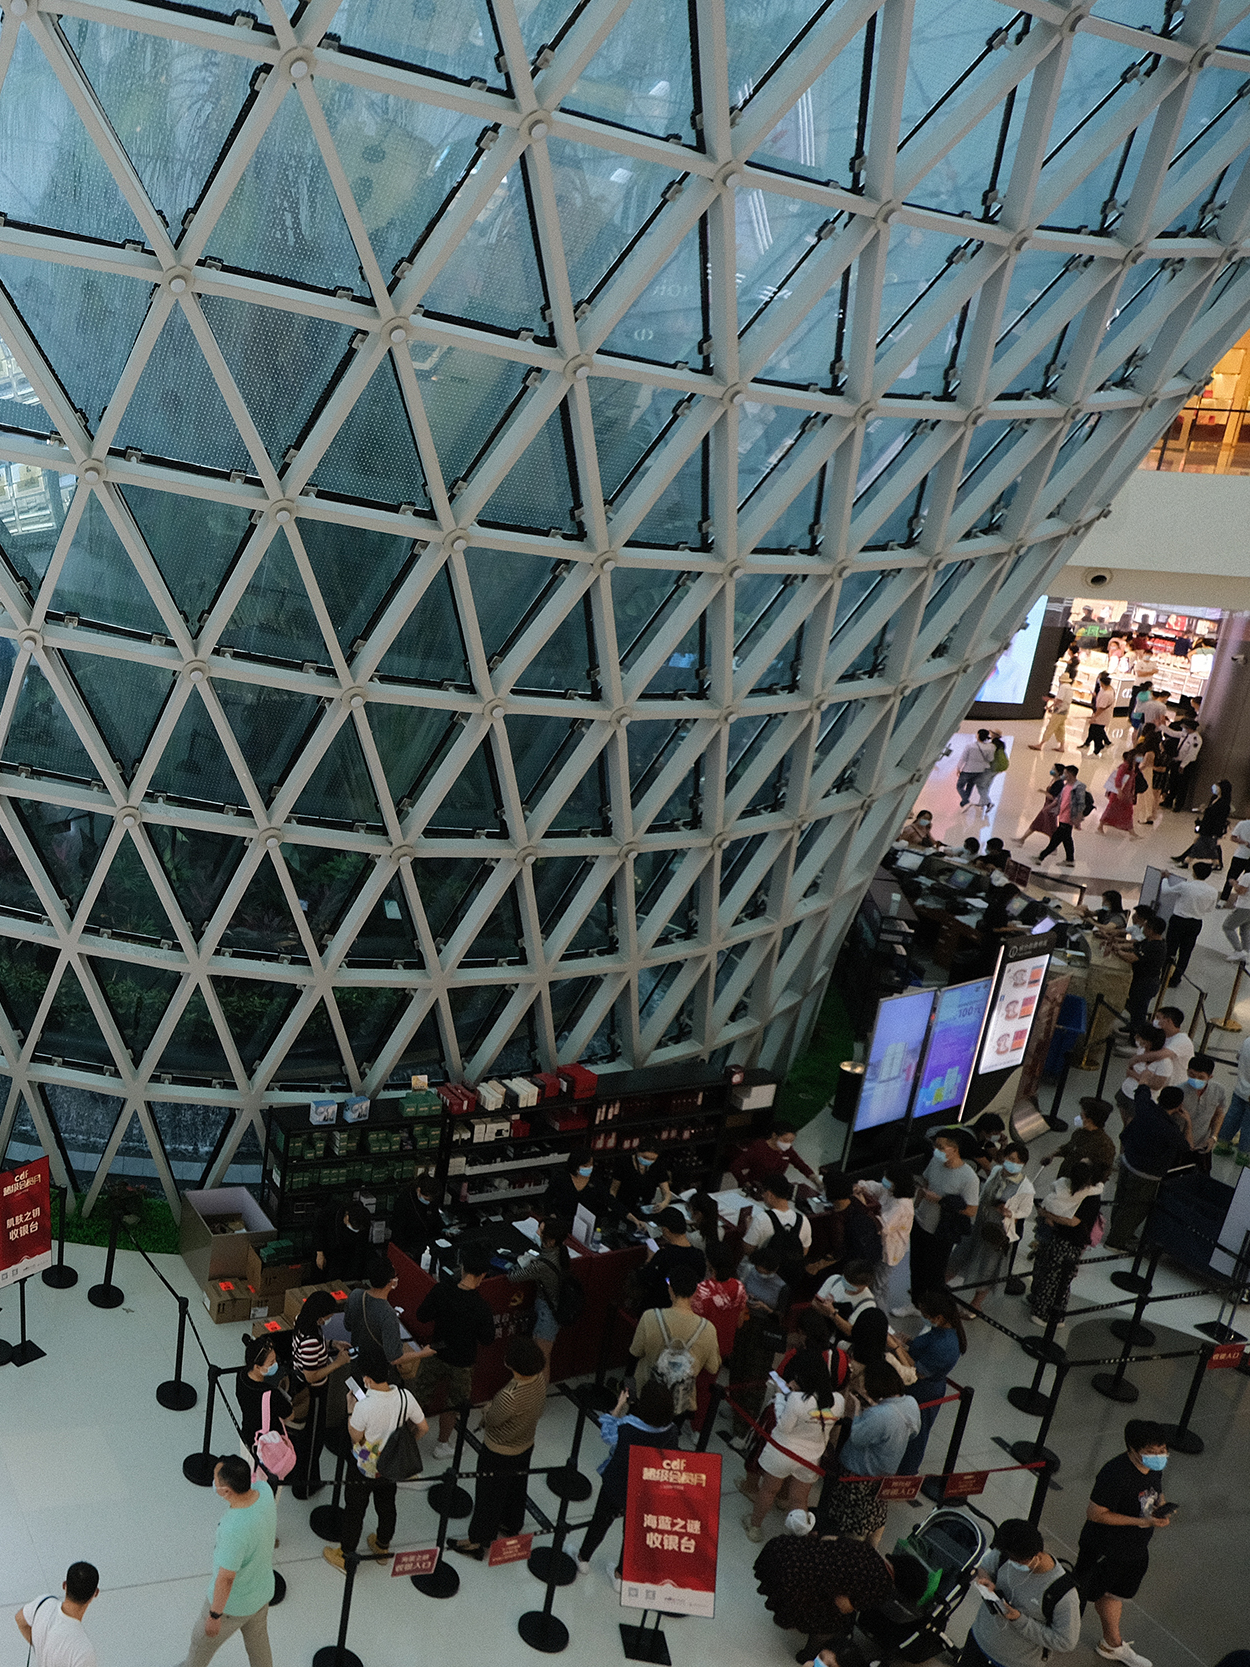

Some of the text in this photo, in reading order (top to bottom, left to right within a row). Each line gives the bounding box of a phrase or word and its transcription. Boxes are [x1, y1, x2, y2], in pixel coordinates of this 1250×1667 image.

[14, 1169, 29, 1182] cdf
[6, 1207, 41, 1229] 肌肤之钥
[9, 1221, 39, 1241] 收银台
[662, 1458, 687, 1471] cdf
[643, 1513, 701, 1535] 海蓝之谜
[646, 1532, 696, 1554] 收银台
